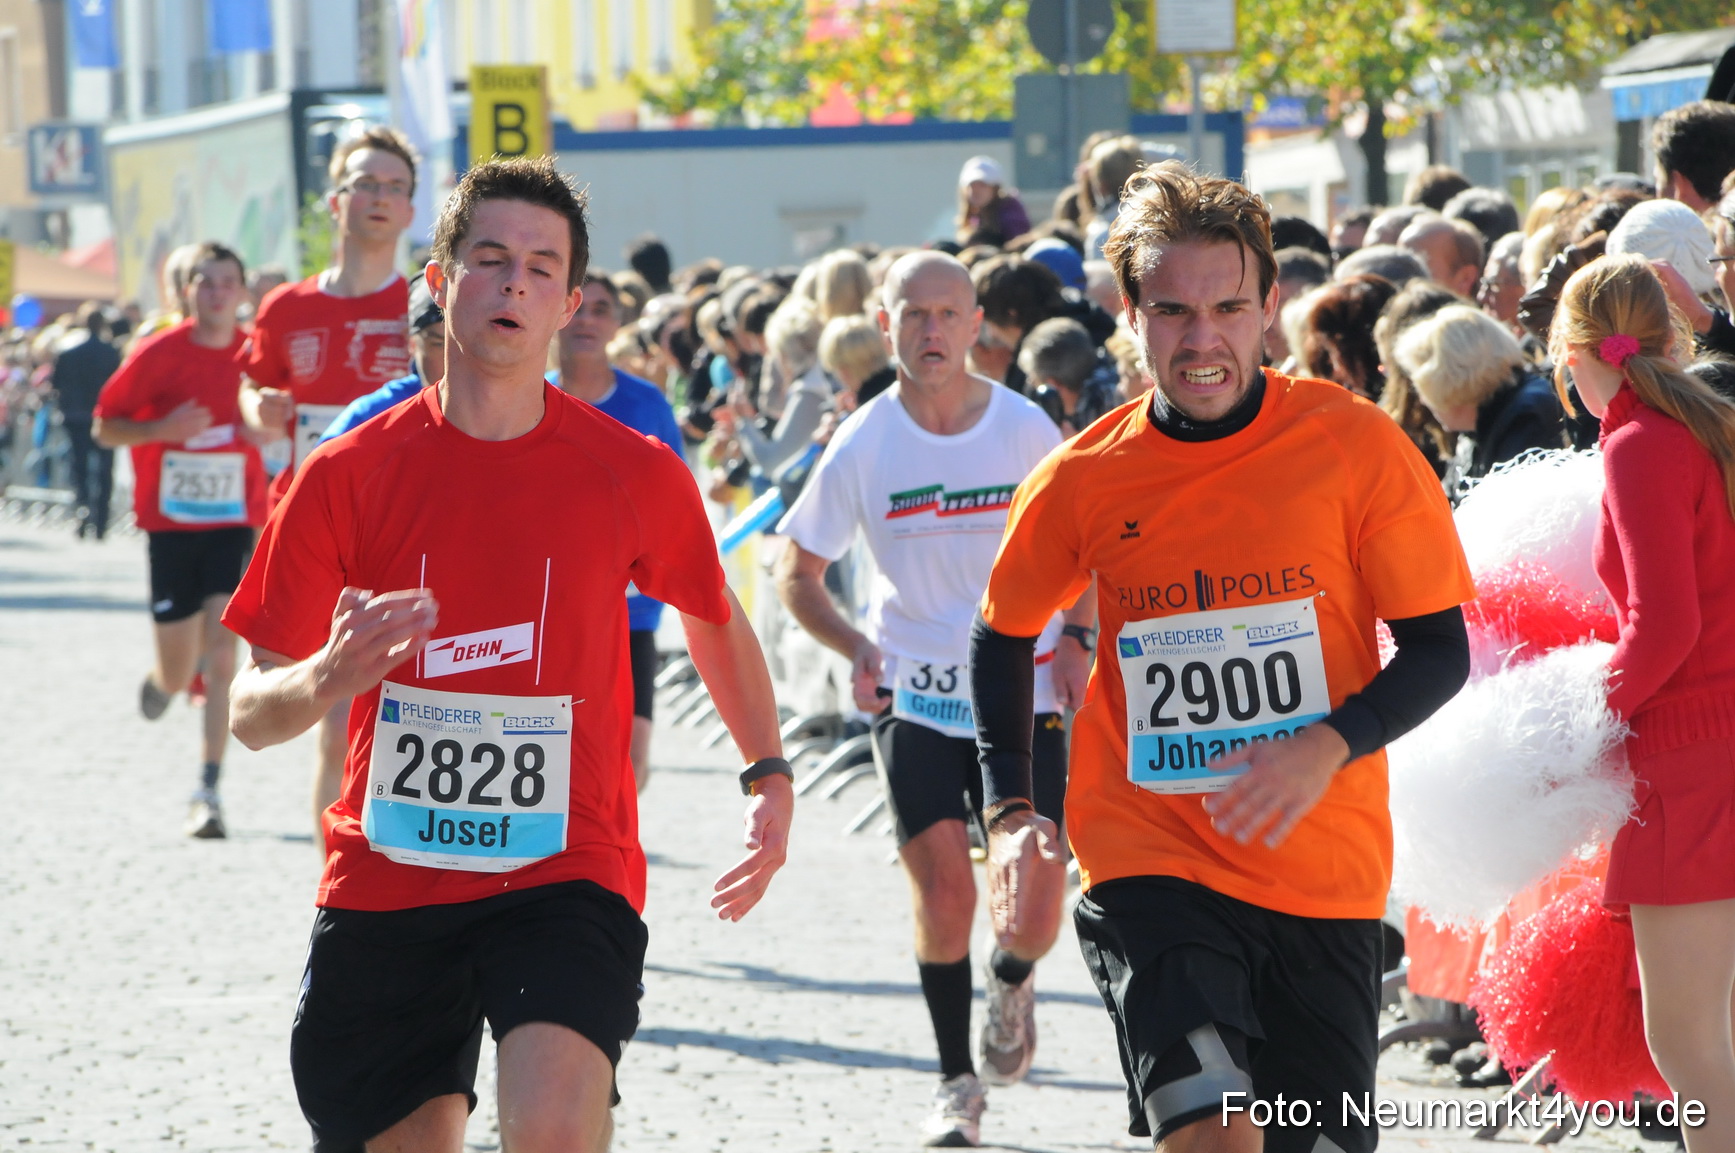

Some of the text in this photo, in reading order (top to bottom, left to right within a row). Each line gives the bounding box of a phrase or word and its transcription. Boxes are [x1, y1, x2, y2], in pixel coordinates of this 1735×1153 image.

[494, 102, 528, 156] B
[172, 470, 234, 500] 2537
[1118, 563, 1316, 611] EURO POLES
[1141, 627, 1225, 646] PFLEIDERER
[1247, 620, 1298, 639] BOCK
[452, 639, 503, 663] DEHN
[1147, 645, 1227, 656] AKTIENGESELLSCHAFT
[910, 664, 968, 693] 33
[1145, 650, 1302, 728] 2900
[402, 702, 482, 725] PFLEIDERER
[502, 716, 555, 728] BOCK
[1136, 719, 1144, 731] B
[402, 719, 482, 735] AKTIENGESELLSCHAFT
[391, 733, 546, 808] 2828
[376, 784, 384, 796] B
[418, 809, 511, 848] Josef
